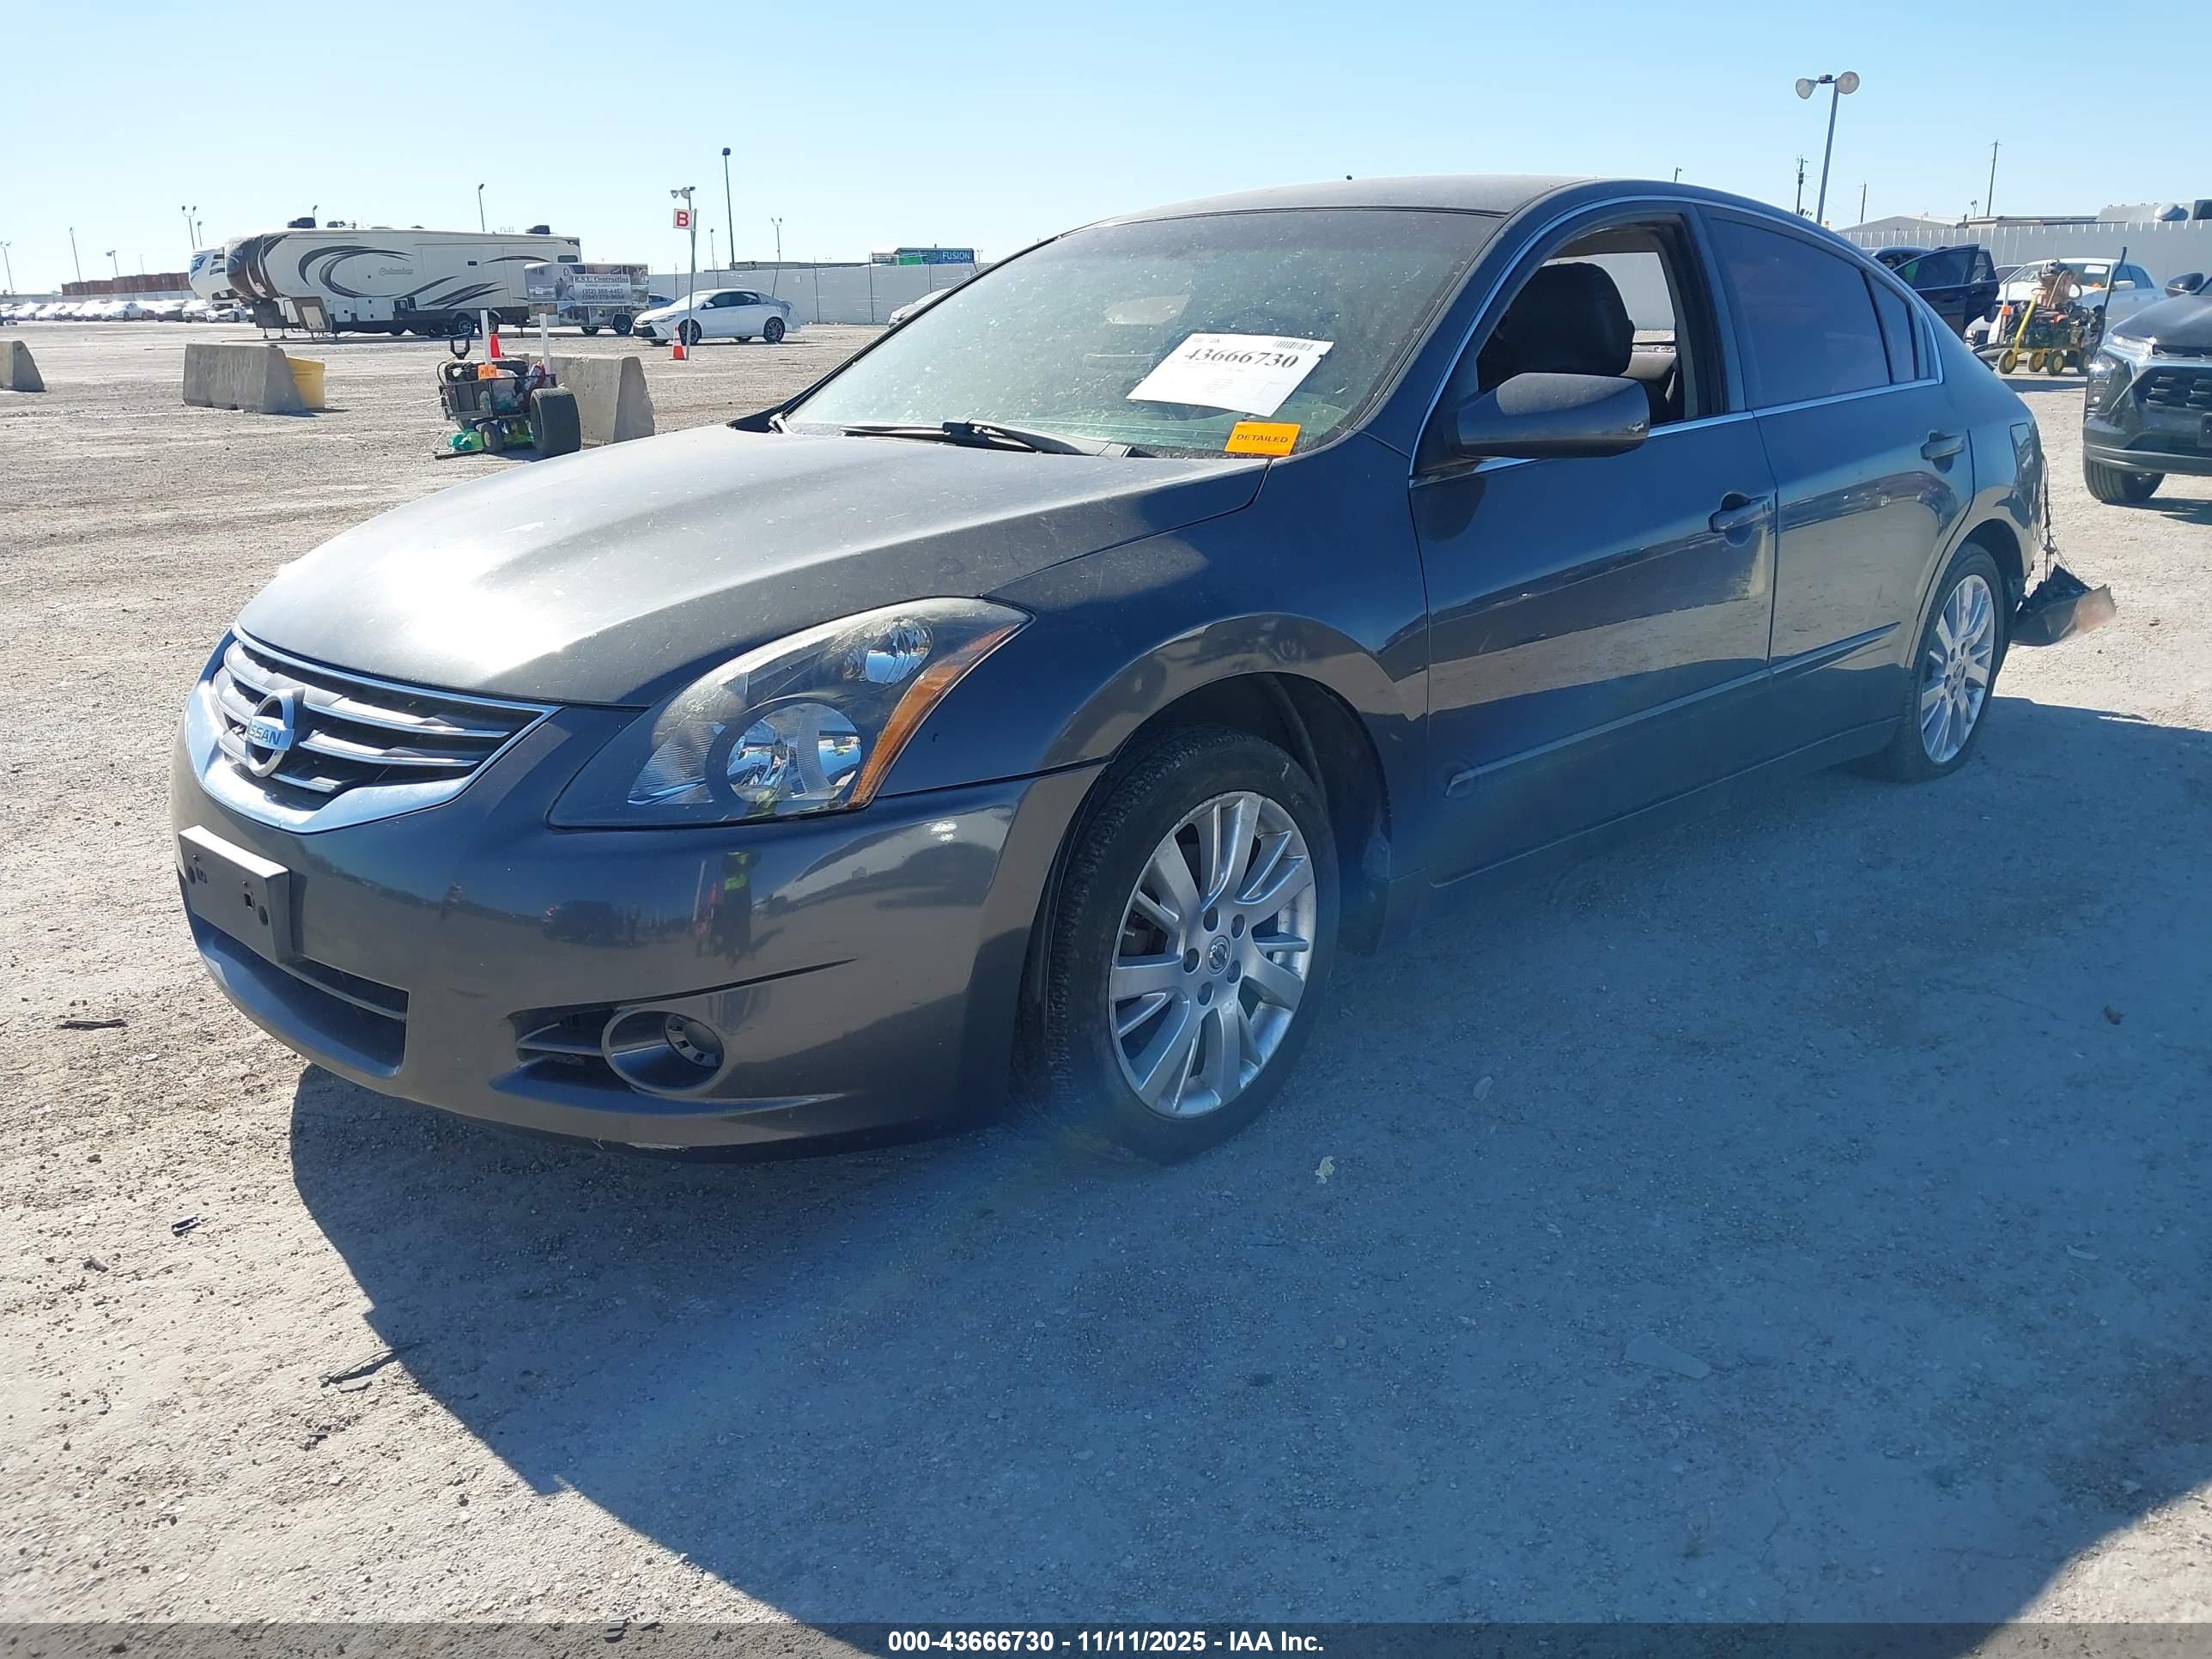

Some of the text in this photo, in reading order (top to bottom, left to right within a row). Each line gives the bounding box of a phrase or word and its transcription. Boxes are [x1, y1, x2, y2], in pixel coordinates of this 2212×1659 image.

[677, 210, 689, 227] B
[942, 251, 970, 260] FUSION
[1184, 349, 1299, 368] 43666730
[1237, 434, 1289, 443] DETAILED
